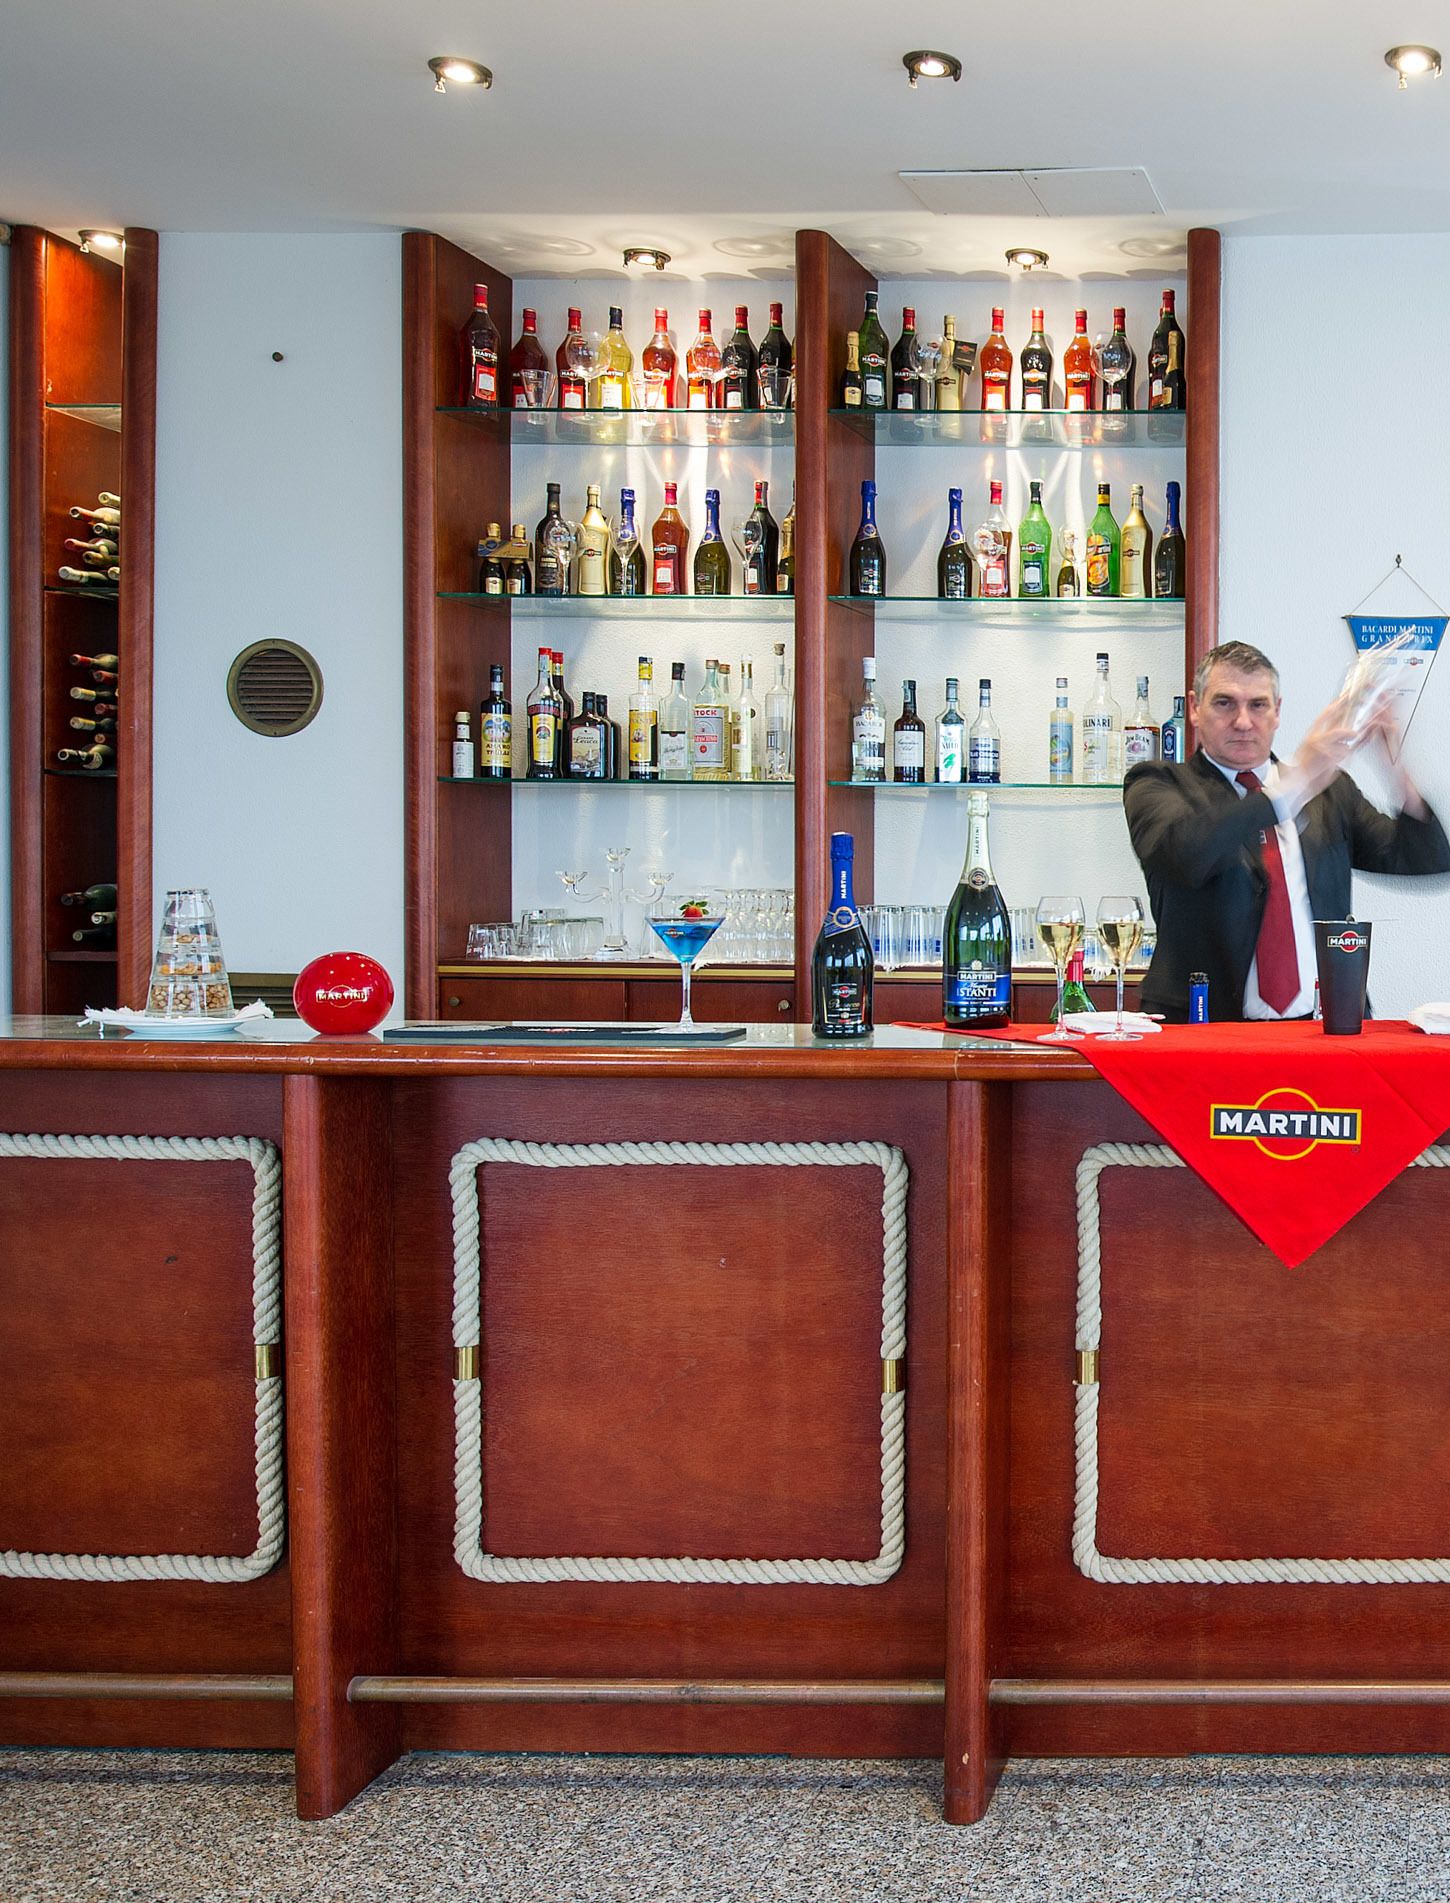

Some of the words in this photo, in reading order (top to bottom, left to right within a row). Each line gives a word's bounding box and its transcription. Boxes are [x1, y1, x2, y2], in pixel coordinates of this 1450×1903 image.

[1361, 625, 1397, 633] BACARDI
[1329, 937, 1367, 946] MARTINI
[1219, 1111, 1351, 1137] MARTINI
